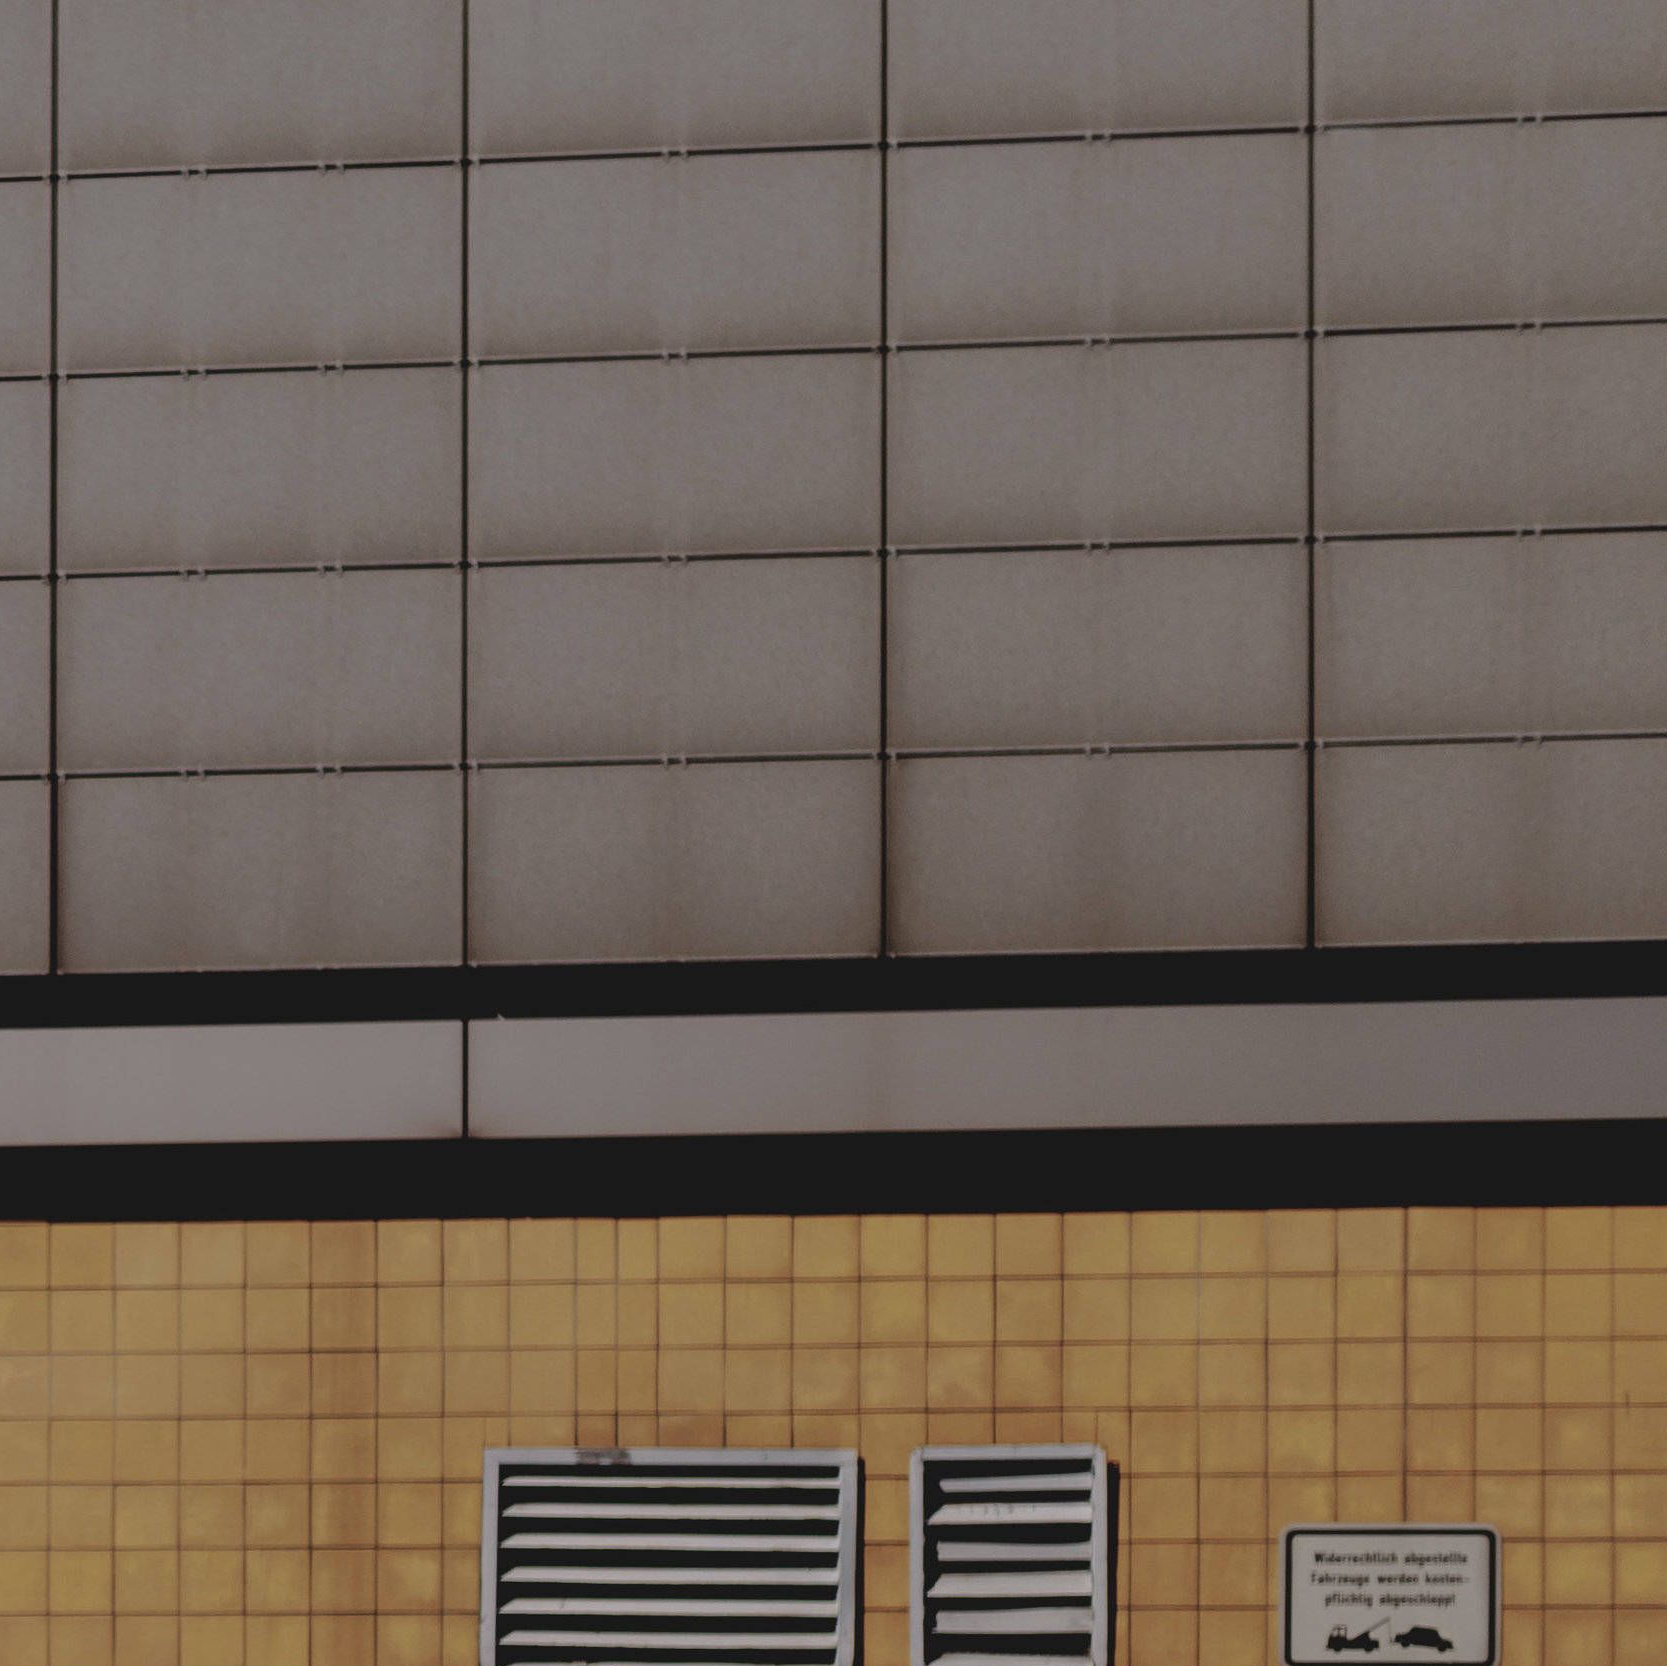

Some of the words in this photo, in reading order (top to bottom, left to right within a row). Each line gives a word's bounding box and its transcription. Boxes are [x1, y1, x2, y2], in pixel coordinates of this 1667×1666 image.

[1314, 1552, 1398, 1564] Widerrechtlich
[1404, 1552, 1468, 1566] abgestellte
[1310, 1572, 1369, 1587] Fahrzeuge
[1377, 1573, 1419, 1584] werden
[1324, 1593, 1373, 1608] pflichtig
